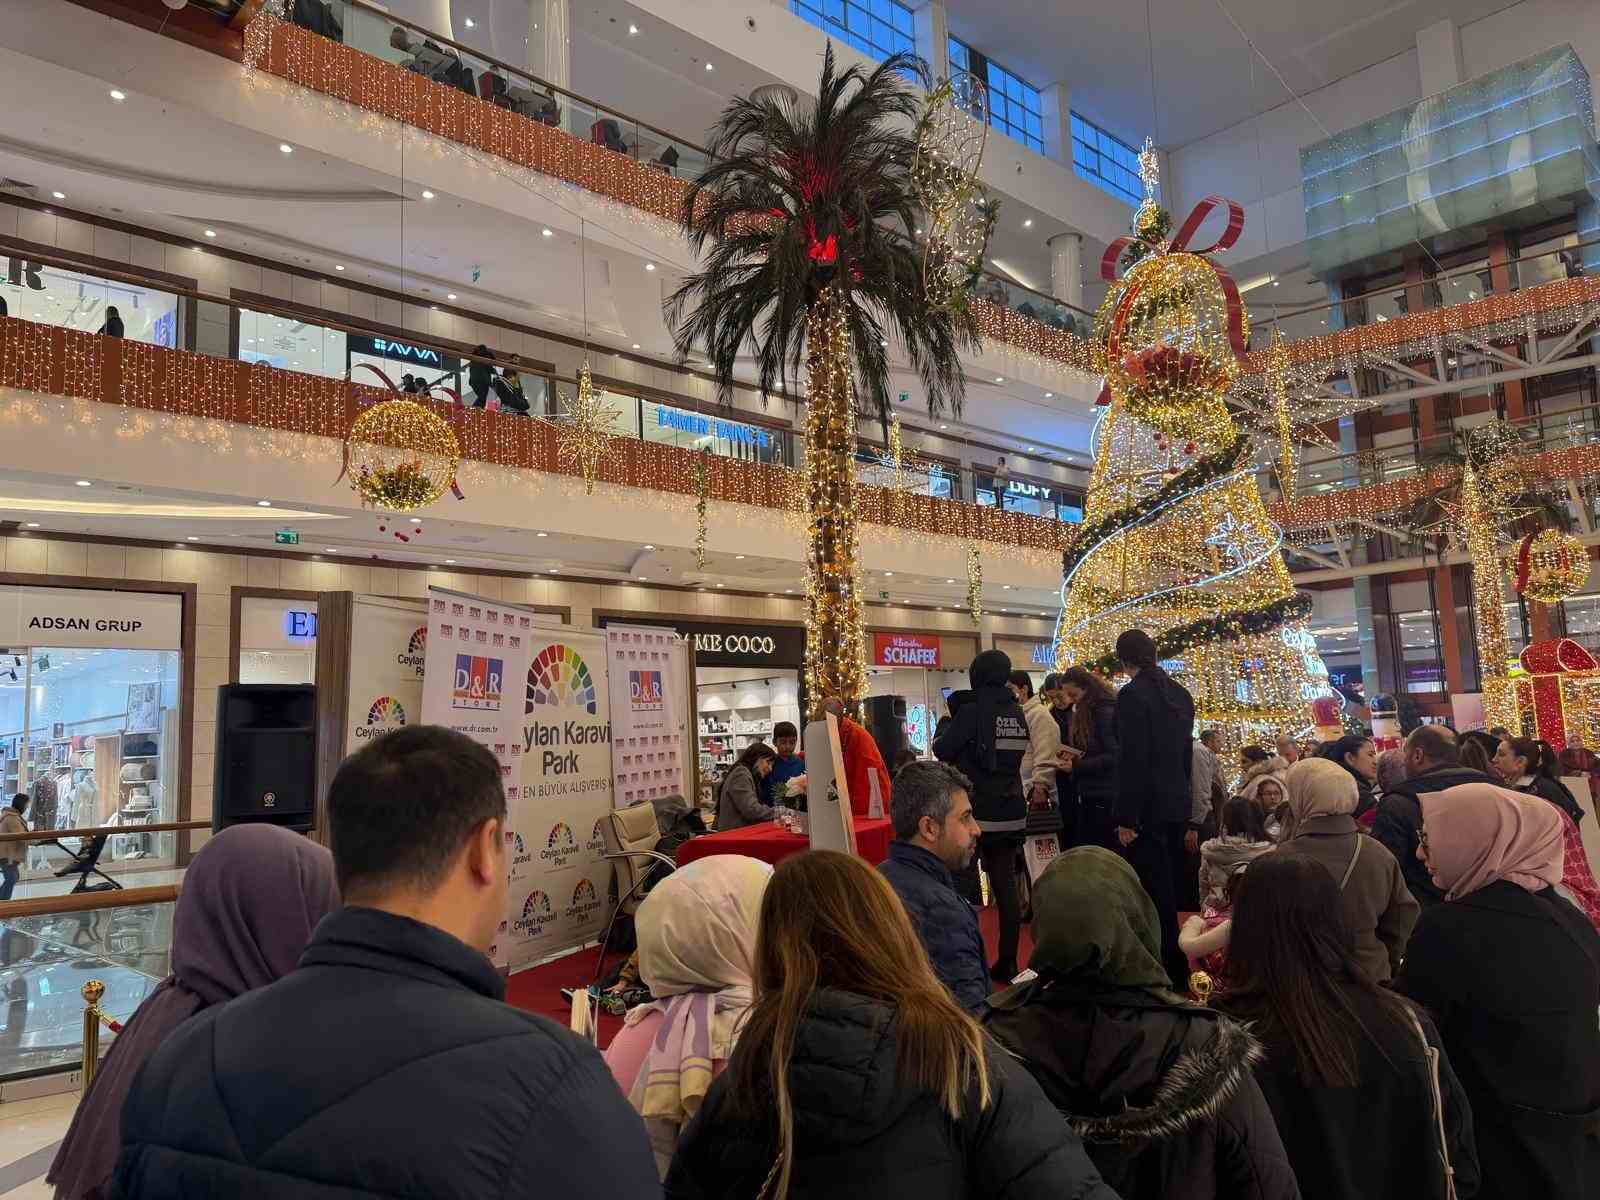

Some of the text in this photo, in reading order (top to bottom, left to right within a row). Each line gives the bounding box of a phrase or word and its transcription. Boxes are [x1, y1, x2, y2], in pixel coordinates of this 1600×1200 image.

[29, 616, 142, 633] ADSAN GRUP
[725, 634, 773, 654] COCO
[884, 646, 937, 664] SCHAFER
[455, 668, 501, 698] D&R
[631, 682, 661, 702] D&R
[543, 750, 579, 775] Park
